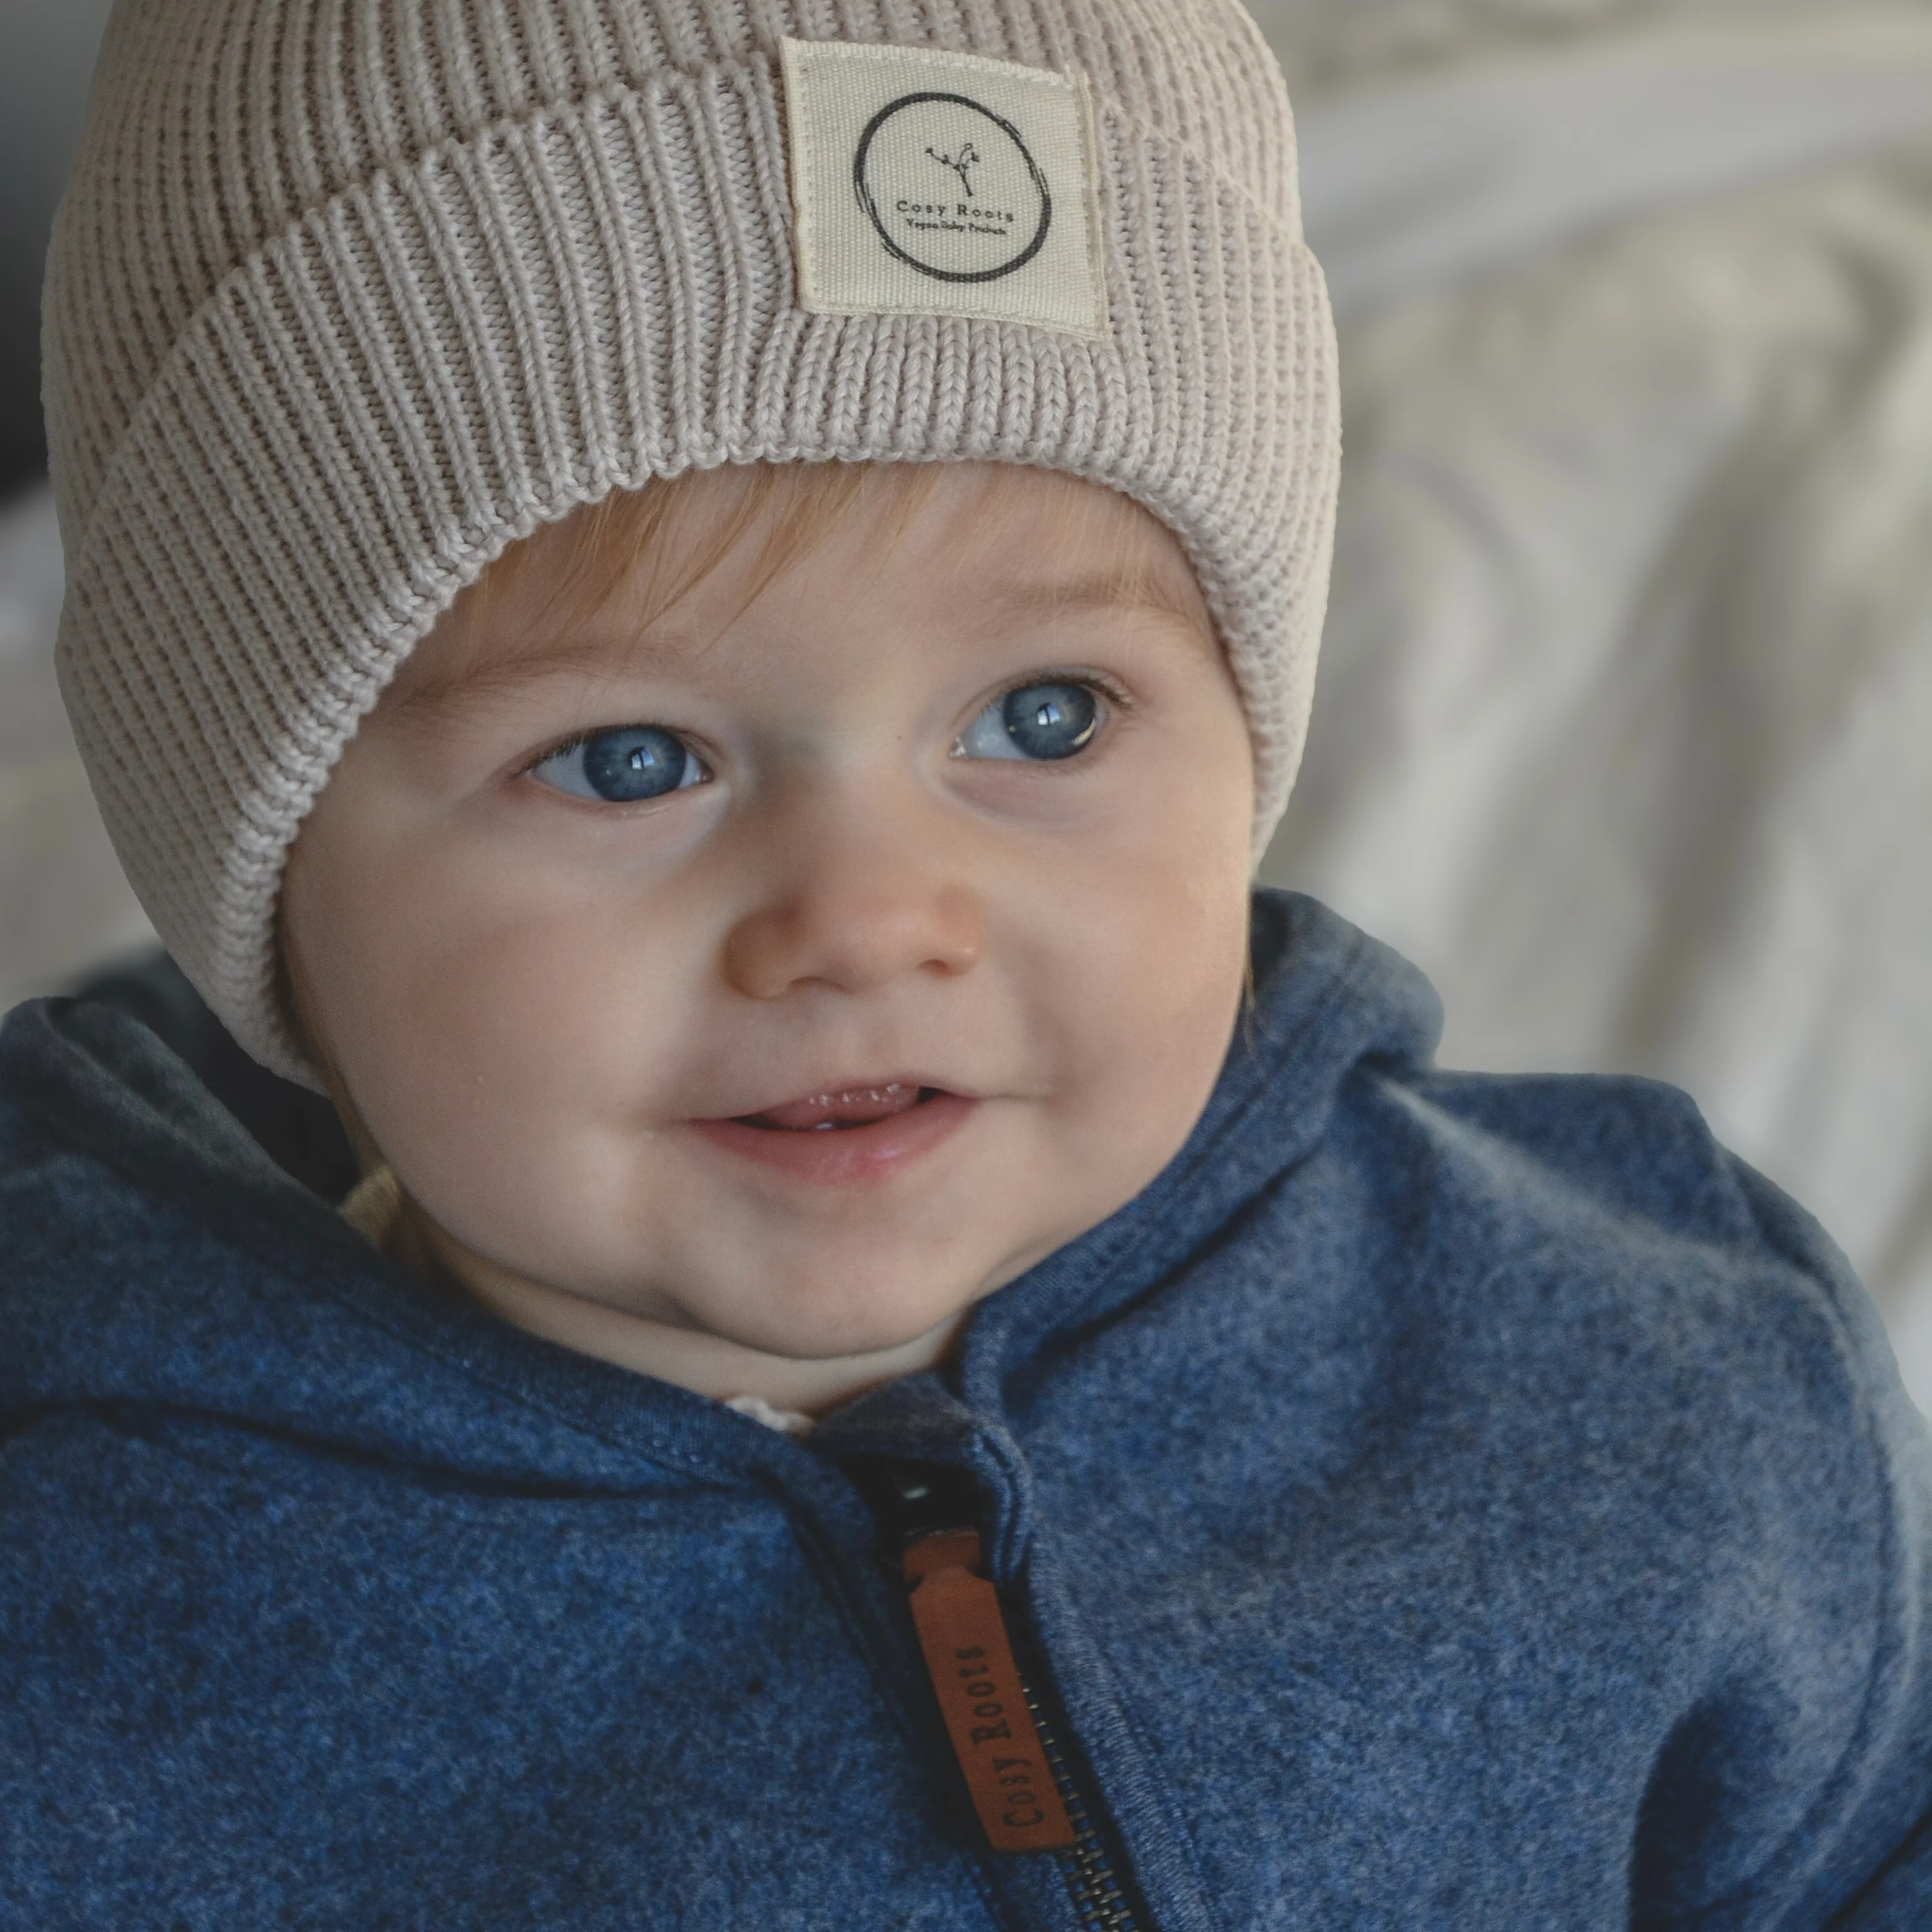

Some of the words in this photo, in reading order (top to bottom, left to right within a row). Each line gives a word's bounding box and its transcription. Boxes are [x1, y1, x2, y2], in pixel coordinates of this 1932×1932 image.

[896, 200, 946, 216] Cosy
[957, 204, 1014, 222] Roots
[906, 218, 939, 231] Vegan
[941, 221, 966, 232] Baby
[955, 1645, 1012, 1746] Roots
[992, 1757, 1043, 1828] Cosy
